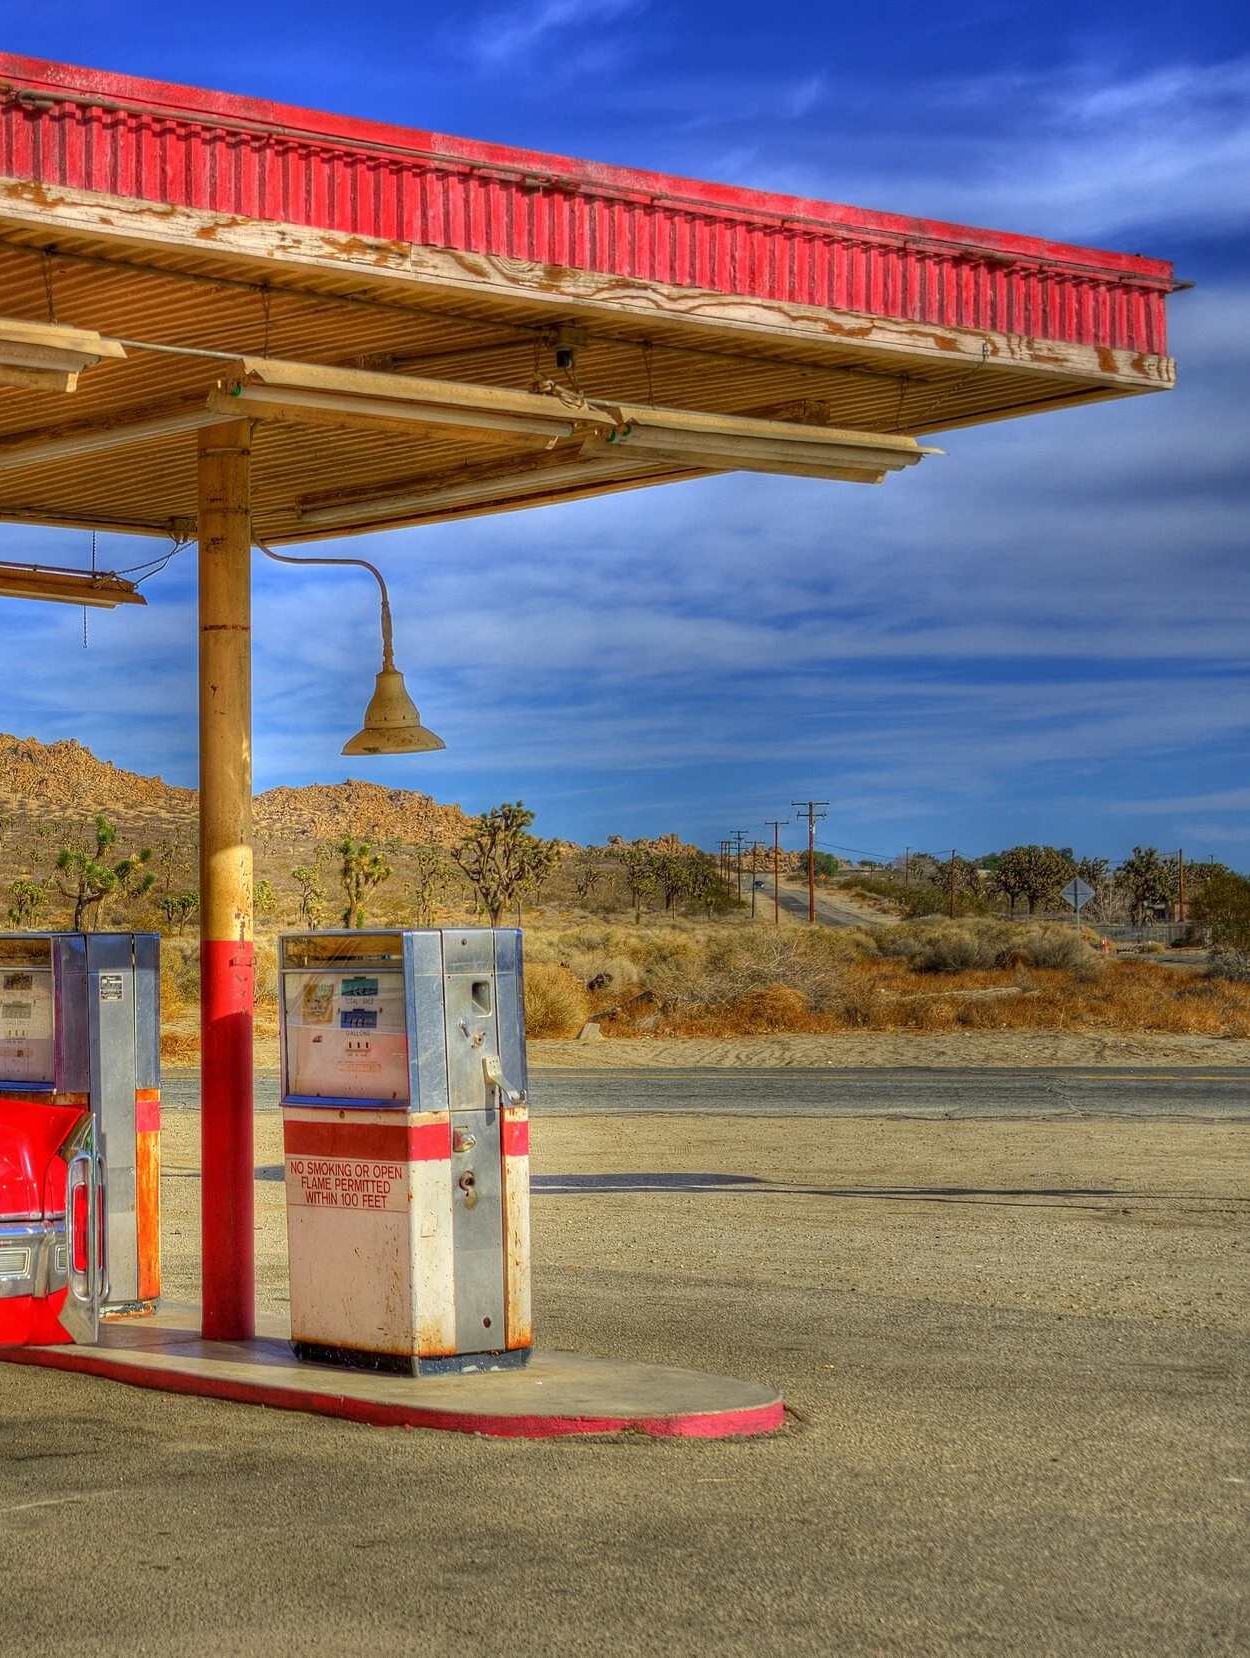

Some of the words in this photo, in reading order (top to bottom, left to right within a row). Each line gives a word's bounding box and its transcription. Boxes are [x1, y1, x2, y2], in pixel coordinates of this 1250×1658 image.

[290, 1161, 304, 1175] NO
[307, 1161, 352, 1177] SMOKING
[355, 1164, 370, 1178] OR
[373, 1165, 402, 1180] OPEN
[301, 1176, 332, 1190] FLAME
[334, 1178, 391, 1194] PERMITTED
[305, 1191, 338, 1205] WITHIN
[341, 1193, 359, 1207] 100
[362, 1194, 388, 1208] FEET
